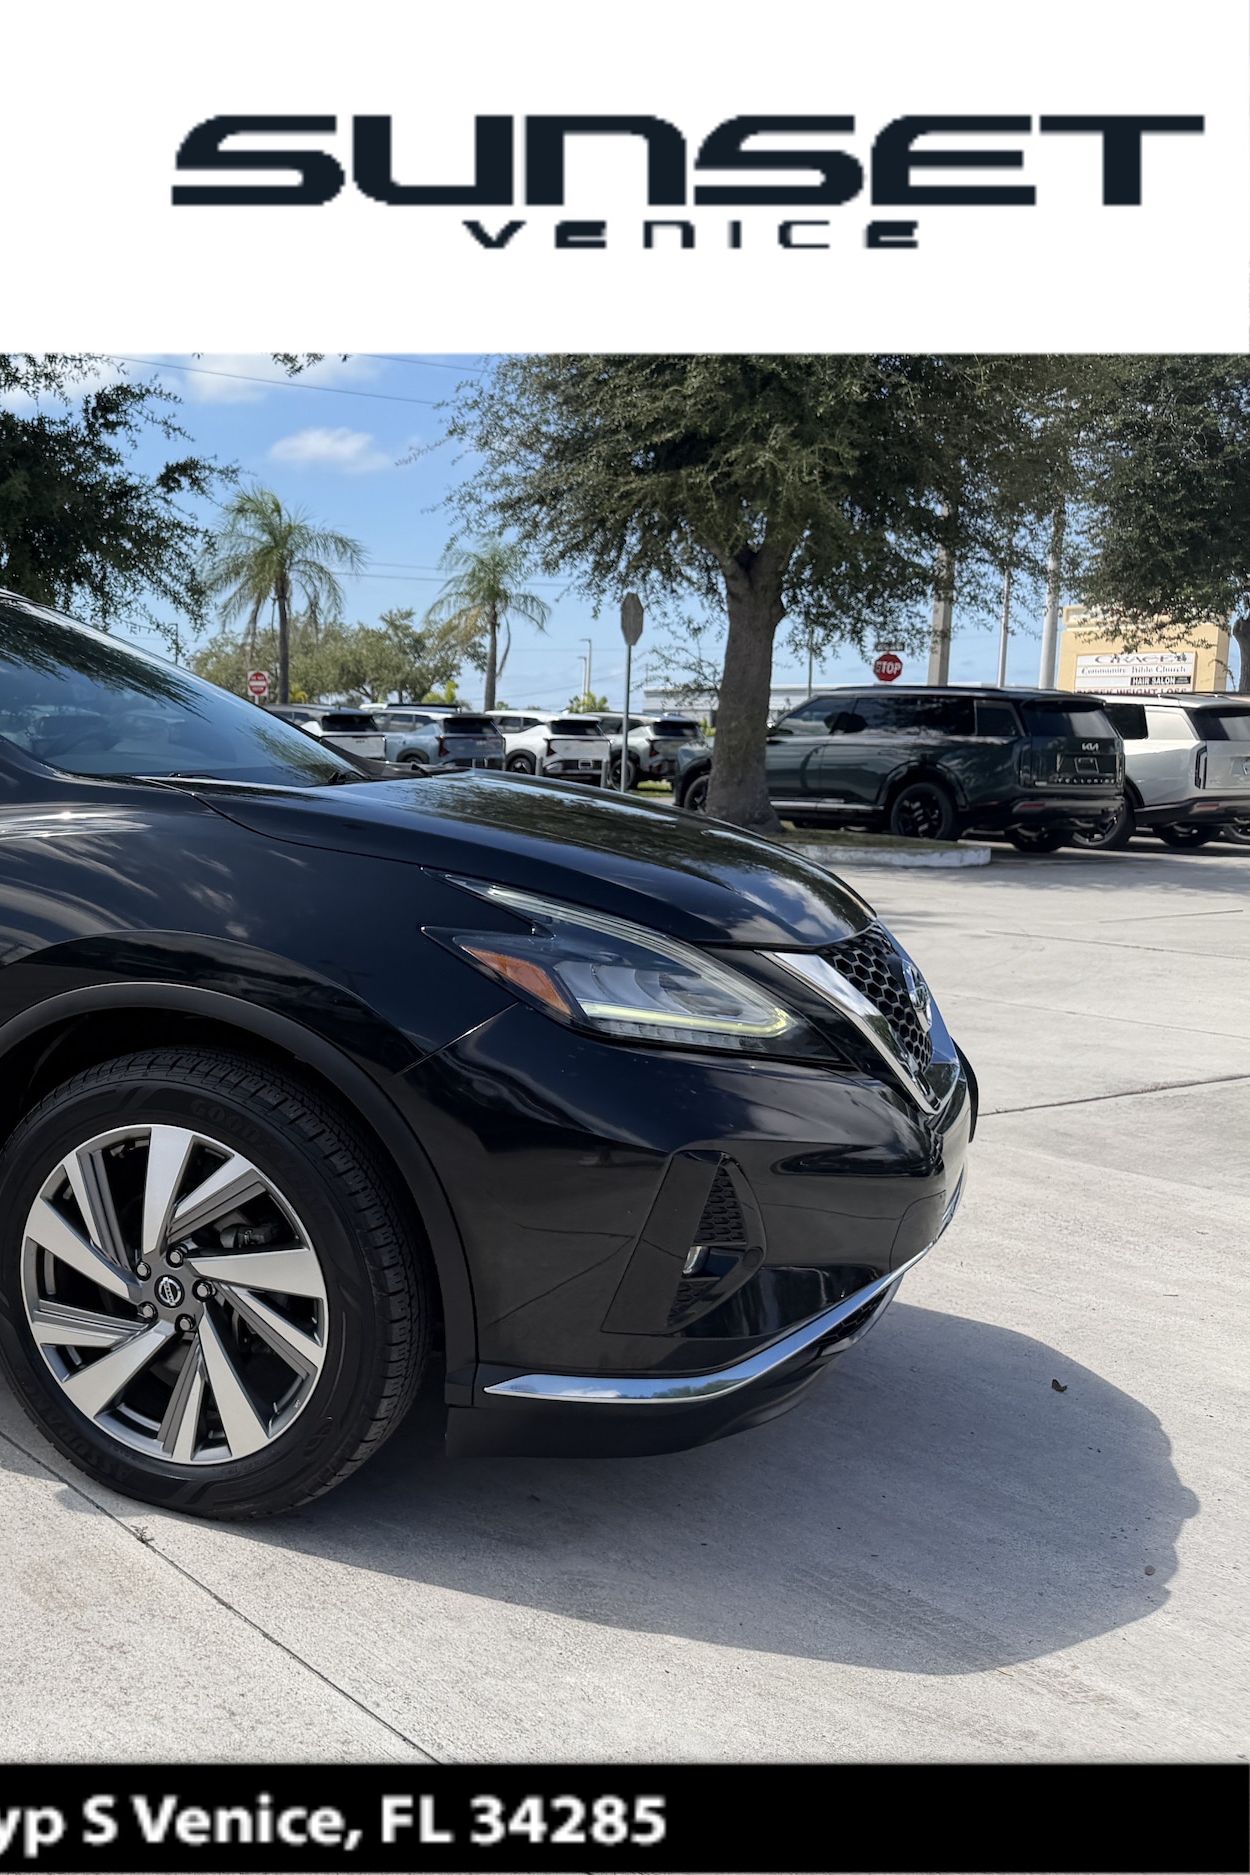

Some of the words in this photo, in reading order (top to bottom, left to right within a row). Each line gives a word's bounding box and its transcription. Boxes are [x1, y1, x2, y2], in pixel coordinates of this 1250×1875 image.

[875, 661, 901, 675] STOP
[1131, 666, 1153, 674] Bible
[1155, 665, 1186, 674] Church
[1132, 677, 1149, 686] HAIR
[1152, 676, 1176, 685] SALON
[1081, 743, 1099, 751] KIA
